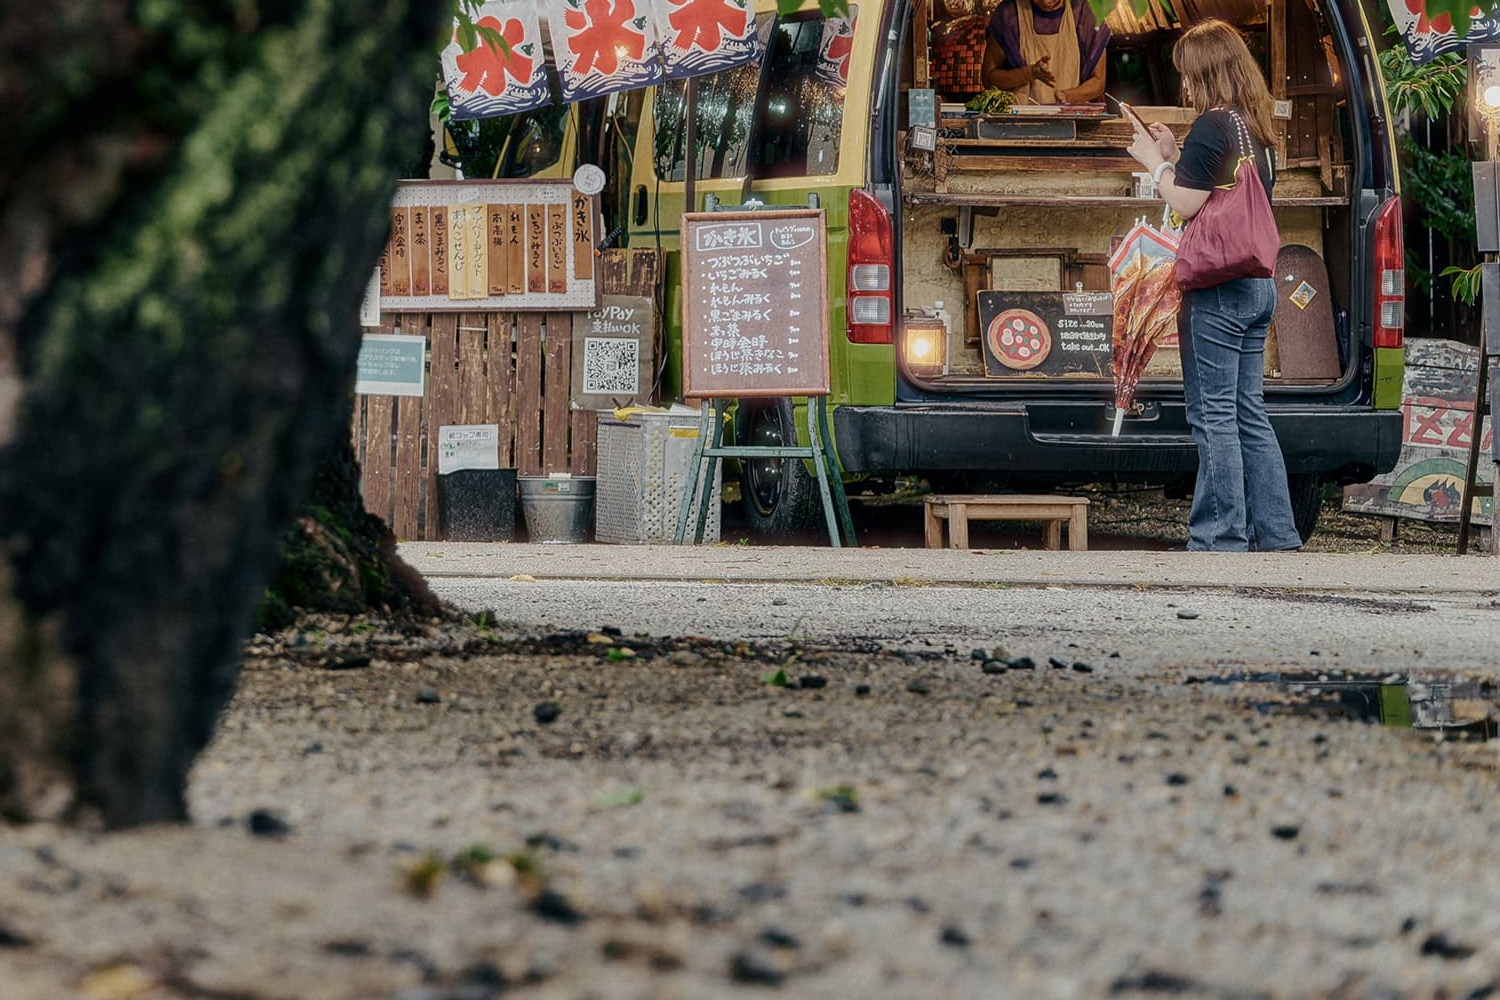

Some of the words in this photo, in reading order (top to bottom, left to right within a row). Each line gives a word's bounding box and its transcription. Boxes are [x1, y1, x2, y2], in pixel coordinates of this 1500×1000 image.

[455, 15, 533, 97] 氷
[414, 212, 427, 246] まっ茶
[492, 213, 503, 246] 南高梅
[509, 211, 520, 245] れもん
[575, 196, 590, 243] かき氷
[394, 212, 406, 258] 宇治金時
[434, 213, 446, 274] 黒ごまみるく
[530, 213, 541, 269] いちごみるく
[552, 213, 563, 270] つぶつぶいちご
[703, 226, 757, 248] かき氷
[708, 253, 790, 268] つぶつぶいちご
[708, 268, 768, 281] いちごみるく
[710, 282, 743, 296] れもん
[710, 293, 771, 308] れもんみるく
[708, 308, 772, 323] 黒ごまみるく
[709, 323, 741, 338] まっ茶
[710, 349, 785, 363] ほうじ茶きなこ
[1060, 342, 1081, 352] take
[710, 361, 782, 376] ほうじ茶みるく
[1403, 397, 1492, 448] IZZ
